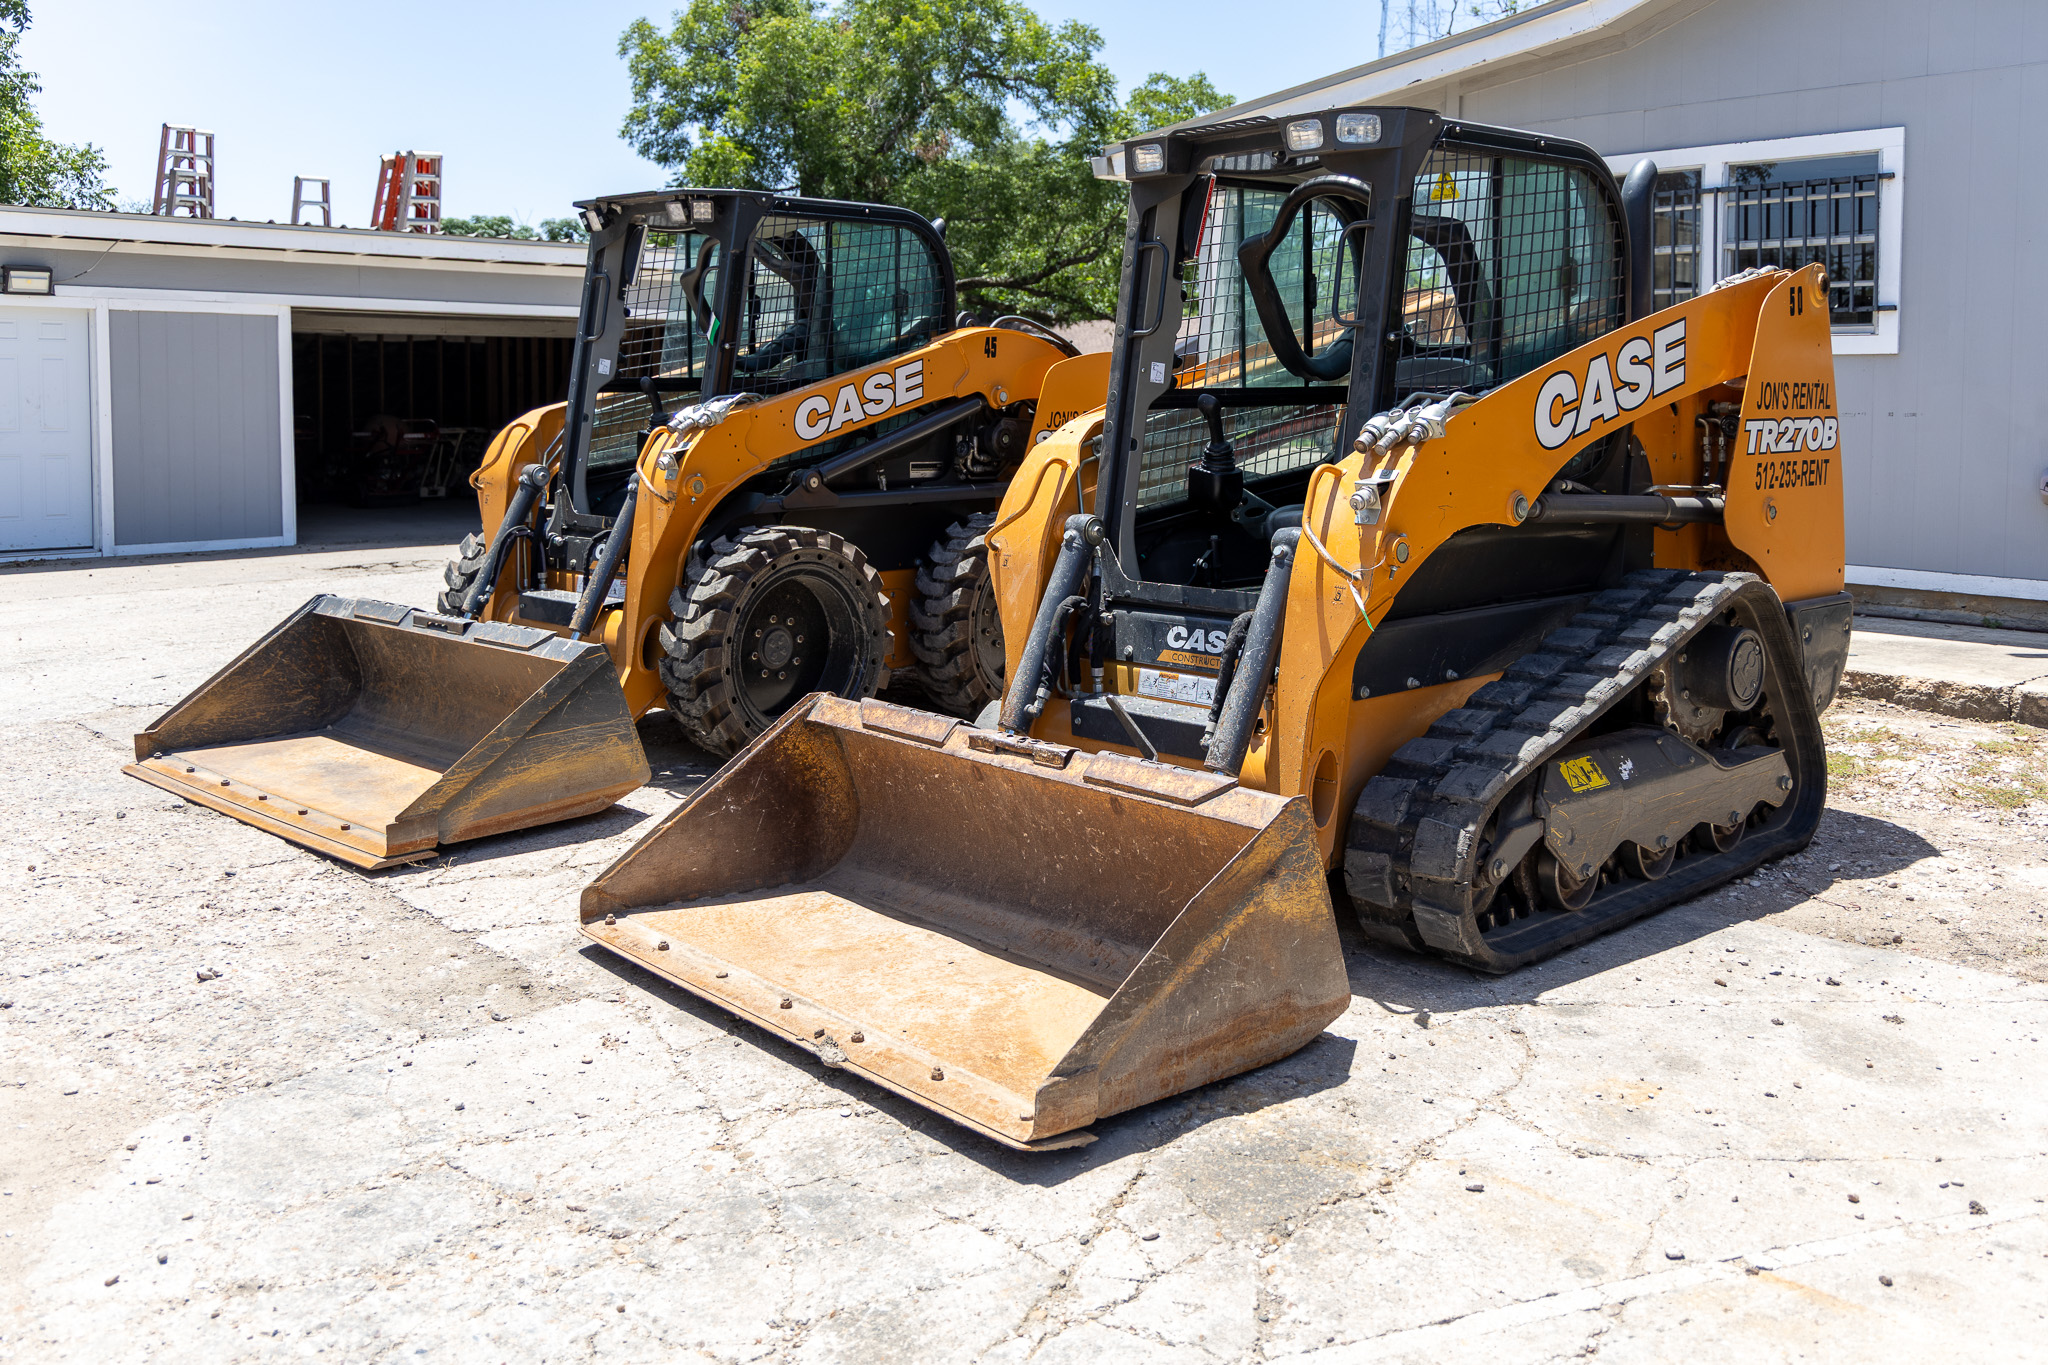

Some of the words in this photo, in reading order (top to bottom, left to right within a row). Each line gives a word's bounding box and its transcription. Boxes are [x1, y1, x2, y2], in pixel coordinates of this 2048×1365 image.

[1790, 286, 1803, 316] 50
[984, 336, 997, 358] 45
[794, 358, 924, 440] CASE
[1534, 317, 1686, 450] CASE
[1757, 381, 1789, 410] JON'S
[1791, 382, 1831, 410] RENTAL
[1744, 416, 1838, 455] TR270B
[1755, 459, 1830, 490] 512-255-RENT
[1166, 625, 1243, 656] CAS
[1171, 652, 1222, 667] CONSTRUCT
